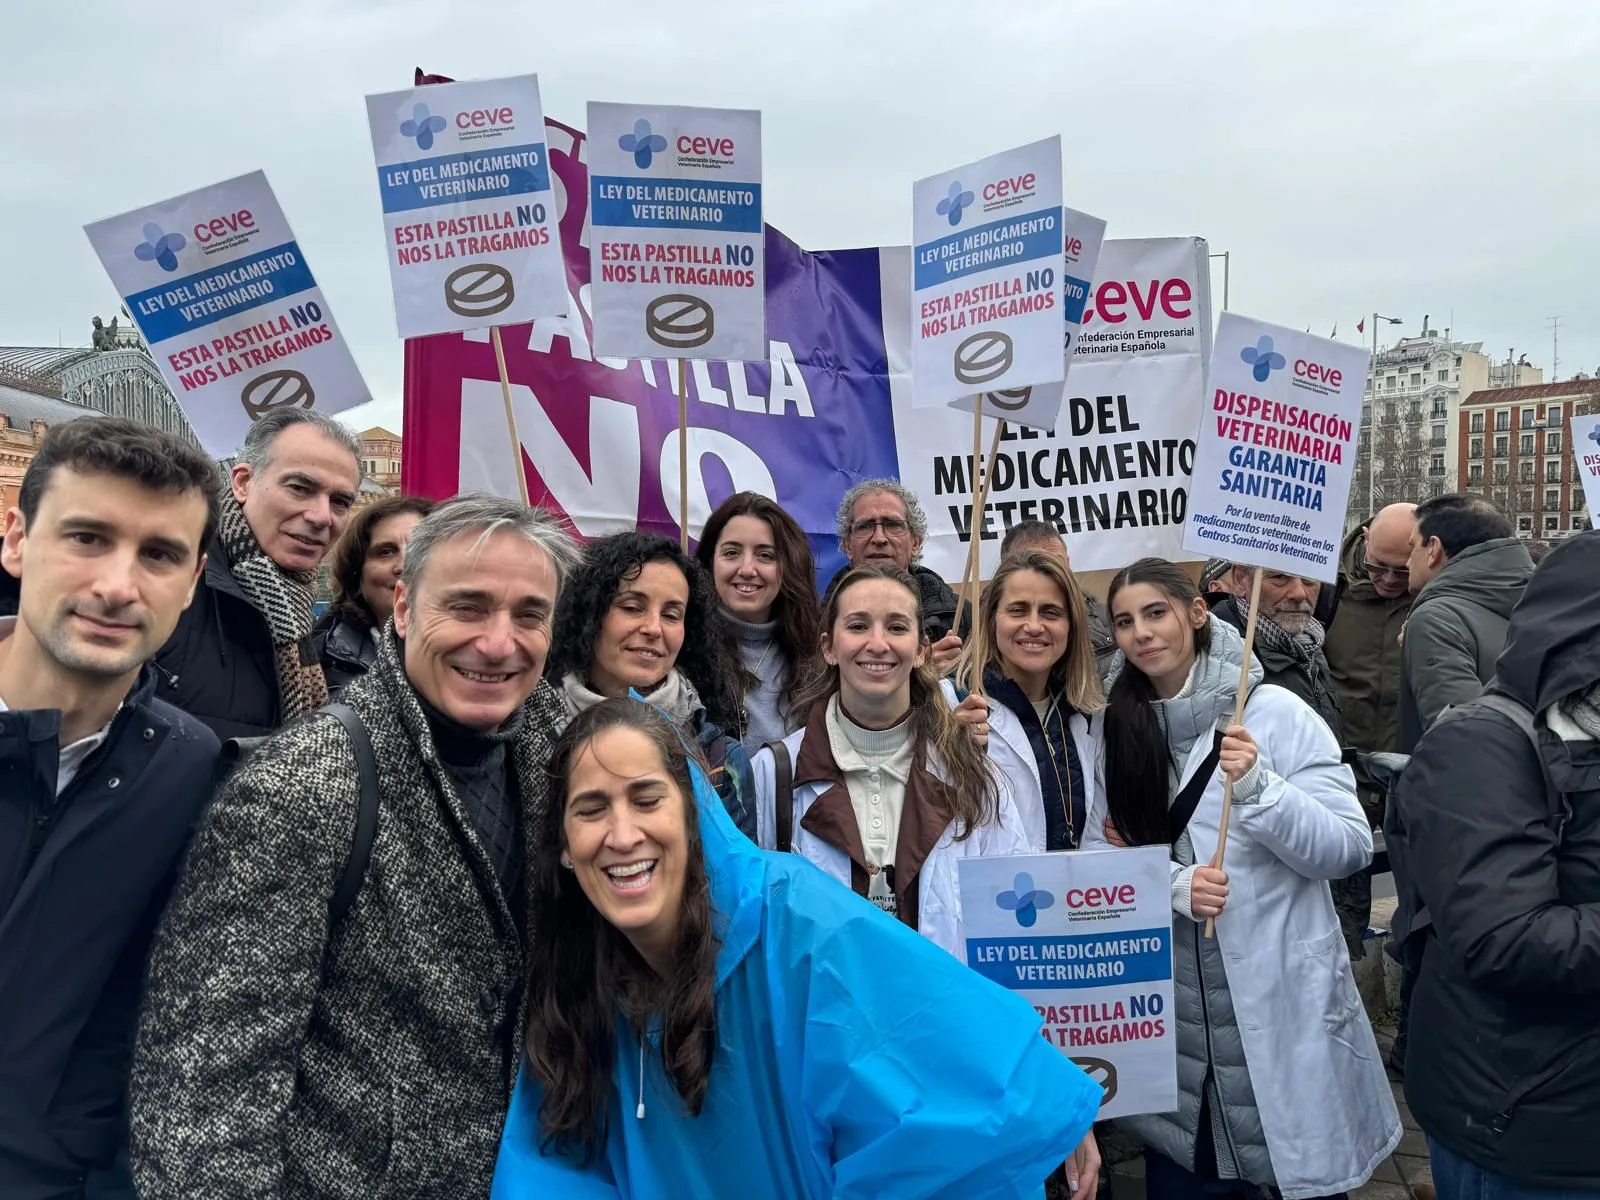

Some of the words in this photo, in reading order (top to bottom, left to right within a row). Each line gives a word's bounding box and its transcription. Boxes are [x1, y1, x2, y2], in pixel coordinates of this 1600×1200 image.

[455, 107, 513, 128] ceve
[676, 135, 734, 156] ceve
[387, 170, 409, 186] LEY
[412, 166, 437, 182] DEL
[439, 151, 538, 178] MEDICAMENTO
[419, 174, 509, 199] VETERINARIO
[599, 184, 623, 199] LEY
[626, 185, 651, 200] DEL
[654, 186, 753, 205] MEDICAMENTO
[982, 173, 1035, 200] ceve
[193, 209, 255, 242] ceve
[394, 222, 434, 245] ESTA
[436, 211, 514, 237] PASTILLA
[516, 203, 545, 226] NO
[631, 204, 722, 222] VETERINARIO
[397, 244, 431, 265] NOS
[434, 241, 455, 259] LA
[456, 226, 549, 256] TRAGAMOS
[601, 242, 641, 261] ESTA
[645, 243, 722, 264] PASTILLA
[726, 244, 754, 266] NO
[921, 247, 939, 264] LEY
[941, 241, 961, 258] DEL
[962, 215, 1054, 251] MEDICAMENTO
[1065, 235, 1082, 256] ve
[945, 241, 1024, 273] VETERINARIO
[138, 294, 165, 315] LEY
[165, 286, 196, 306] DEL
[193, 251, 295, 296] MEDICAMENTO
[602, 264, 636, 282] NOS
[640, 265, 660, 283] LA
[664, 266, 754, 287] TRAGAMOS
[179, 279, 273, 321] VETERINARIO
[921, 295, 950, 319] ESTA
[954, 277, 1022, 309] PASTILLA
[1026, 267, 1054, 292] NO
[921, 316, 947, 338] NOS
[950, 311, 966, 331] LA
[968, 291, 1054, 325] TRAGAMOS
[167, 344, 214, 372] ESTA
[211, 315, 292, 356] PASTILLA
[288, 301, 321, 328] NO
[1078, 330, 1134, 342] nfederación
[1138, 327, 1195, 340] Empresarial
[1121, 340, 1166, 353] Española
[178, 364, 218, 391] NOS
[216, 356, 243, 377] LA
[238, 323, 332, 368] TRAGAMOS
[1294, 359, 1342, 387] ceve
[1069, 394, 1140, 436] DEL
[1213, 388, 1352, 442] DISPENSACIÓN
[1217, 415, 1341, 464] VETERINARIA
[458, 377, 778, 542] NO
[934, 438, 1196, 495] MEDICAMENTO
[1228, 445, 1325, 487] GARANTÍA
[1219, 468, 1322, 512] SANITARIA
[948, 488, 1188, 542] VETERINARIO
[1224, 504, 1242, 516] Por
[1241, 507, 1252, 519] la
[1253, 512, 1280, 524] venta
[1280, 514, 1300, 529] libre
[1299, 520, 1310, 532] de
[1192, 514, 1260, 534] medicamentos
[1261, 527, 1311, 546] veterinarios
[1311, 539, 1322, 549] en
[1322, 539, 1334, 552] los
[1197, 526, 1230, 542] Centros
[1230, 533, 1279, 552] Sanitarios
[1280, 542, 1328, 564] Veterinarios
[1066, 884, 1135, 908] ceve
[1106, 906, 1136, 914] Empresarial
[977, 946, 1004, 962] LEY
[1008, 945, 1038, 961] DEL
[1042, 936, 1161, 959] MEDICAMENTO
[1015, 960, 1124, 980] VETERINARIO
[1130, 993, 1163, 1018] NO
[1055, 1019, 1164, 1046] TRAGAMOS
